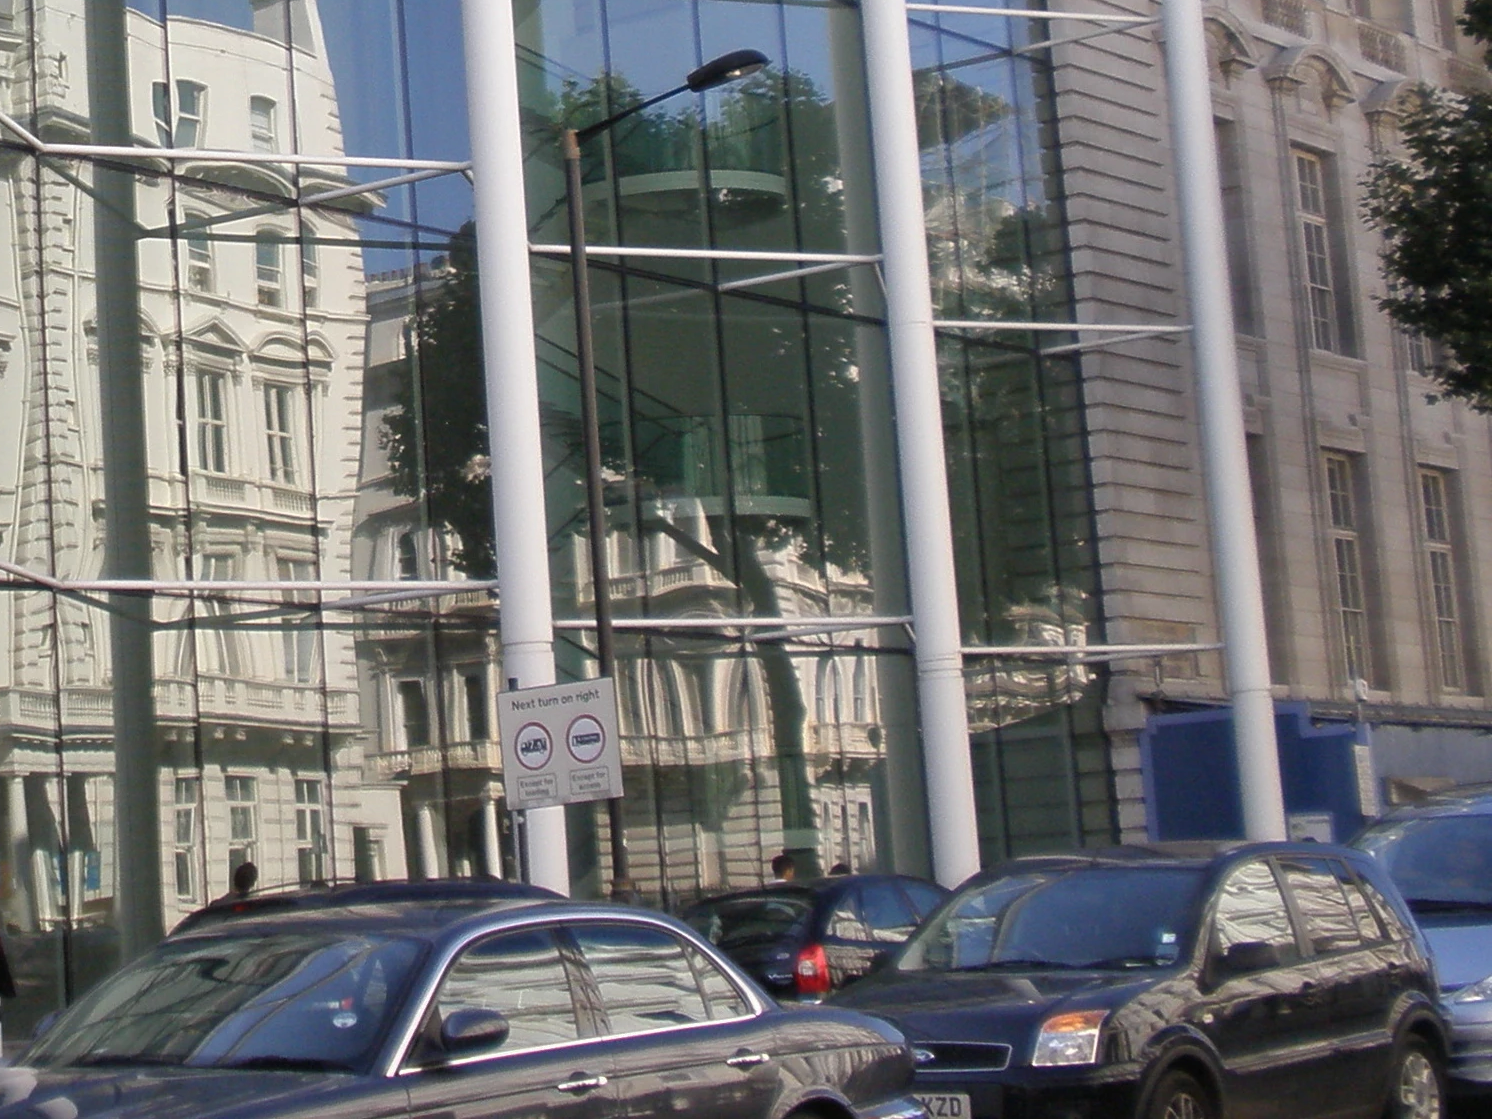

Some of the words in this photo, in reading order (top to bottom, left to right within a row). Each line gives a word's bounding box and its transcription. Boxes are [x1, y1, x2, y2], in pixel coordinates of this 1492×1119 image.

[511, 699, 535, 711] Next
[538, 696, 559, 707] turn
[561, 694, 574, 704] on
[576, 689, 600, 703] right
